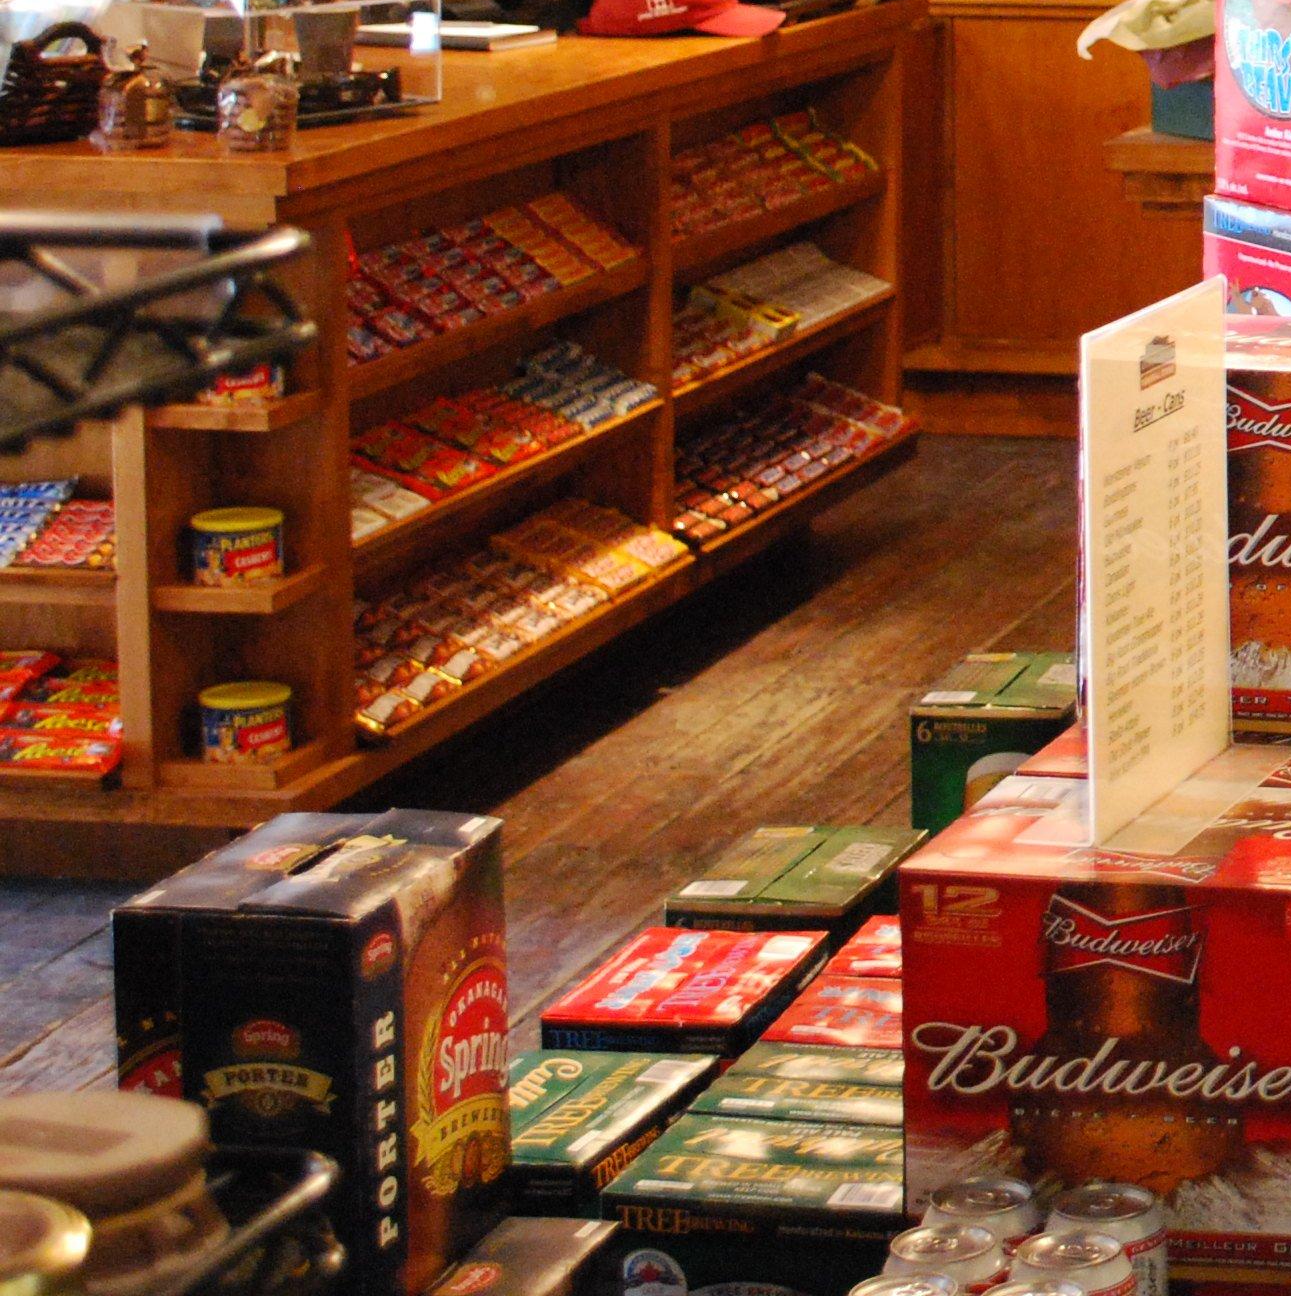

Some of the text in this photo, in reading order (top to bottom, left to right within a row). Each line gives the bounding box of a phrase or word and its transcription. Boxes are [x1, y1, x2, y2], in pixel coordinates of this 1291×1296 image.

[1134, 389, 1186, 429] Beer Cans
[917, 720, 932, 744] 6
[911, 883, 1000, 915] 12
[1042, 911, 1199, 956] Budweiser
[244, 1029, 290, 1046] Spring
[439, 1017, 510, 1099] Spring
[224, 1068, 310, 1087] PORTER
[375, 1010, 399, 1249] PORTER
[657, 1155, 792, 1181] TREE
[617, 1206, 691, 1234] TREE
[1169, 1238, 1257, 1252] MEILLEUR
